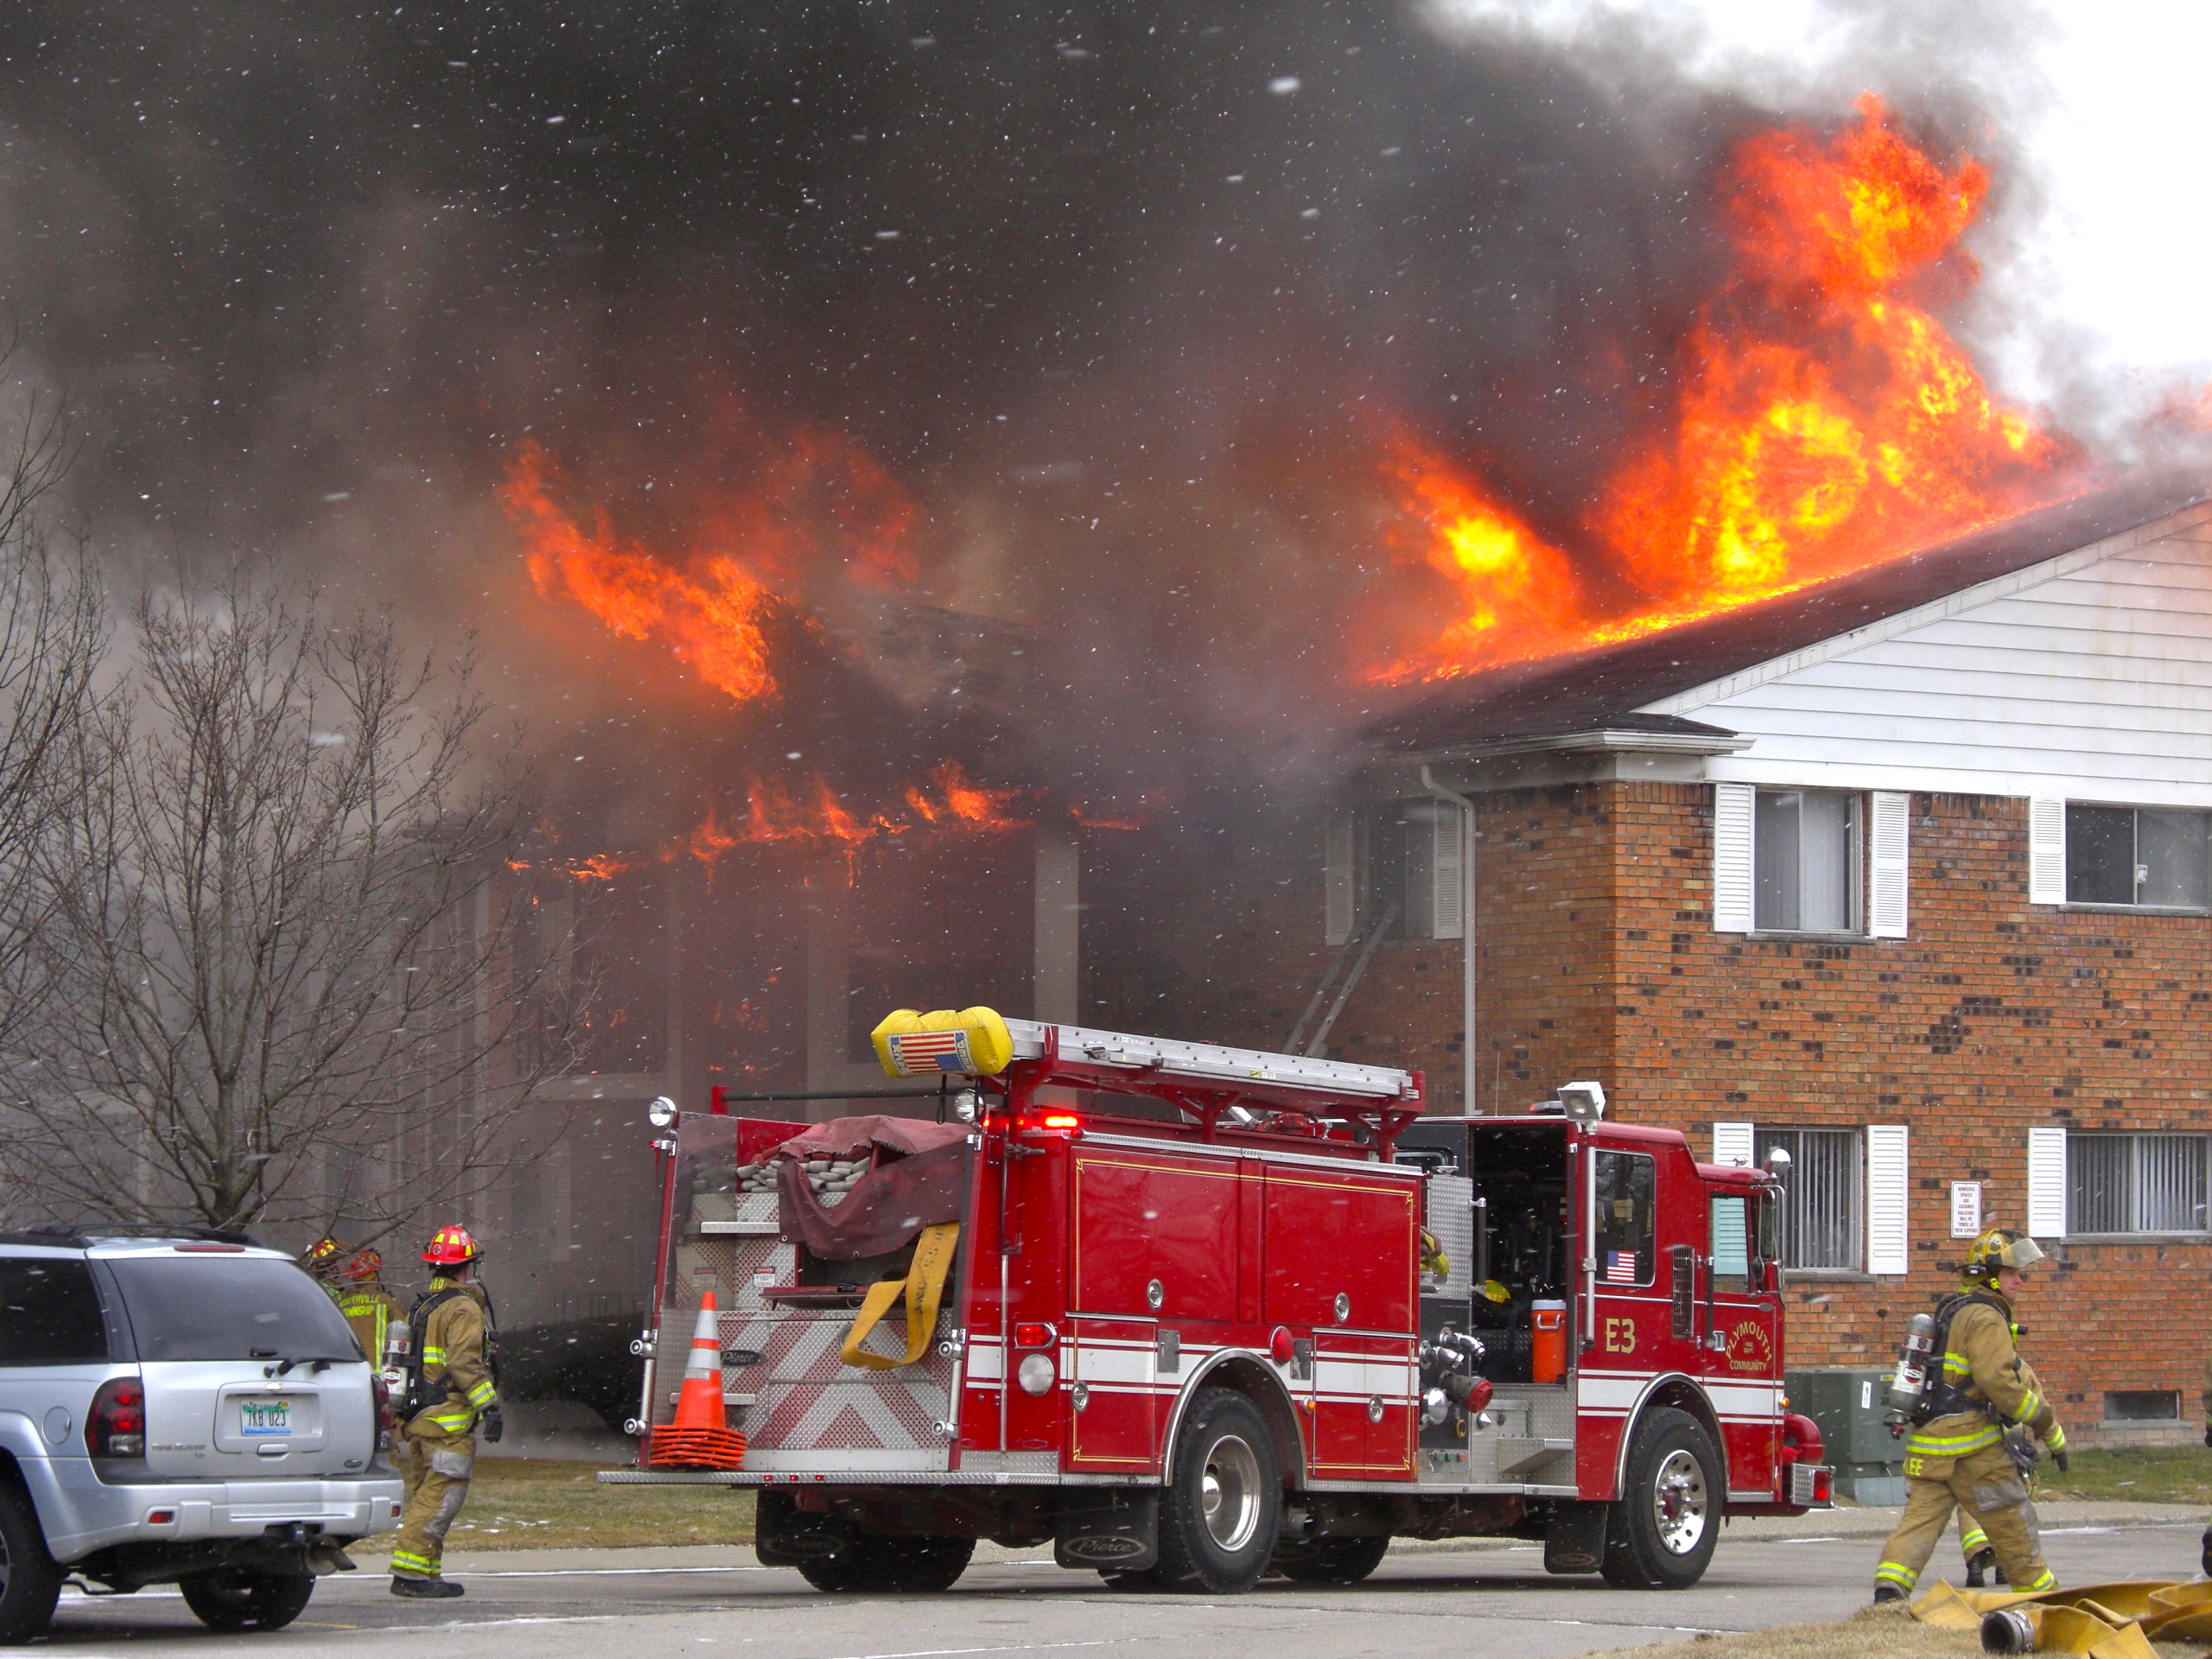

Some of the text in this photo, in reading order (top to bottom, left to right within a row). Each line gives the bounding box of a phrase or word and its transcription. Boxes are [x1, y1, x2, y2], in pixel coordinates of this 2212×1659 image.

[1605, 1318, 1636, 1354] E3
[1726, 1321, 1772, 1362] PLYMOUTH
[721, 1351, 754, 1363] Pierce
[1730, 1360, 1767, 1371] COMMUNITY
[246, 1409, 286, 1427] 7KB U23
[1077, 1539, 1134, 1552] Pierce
